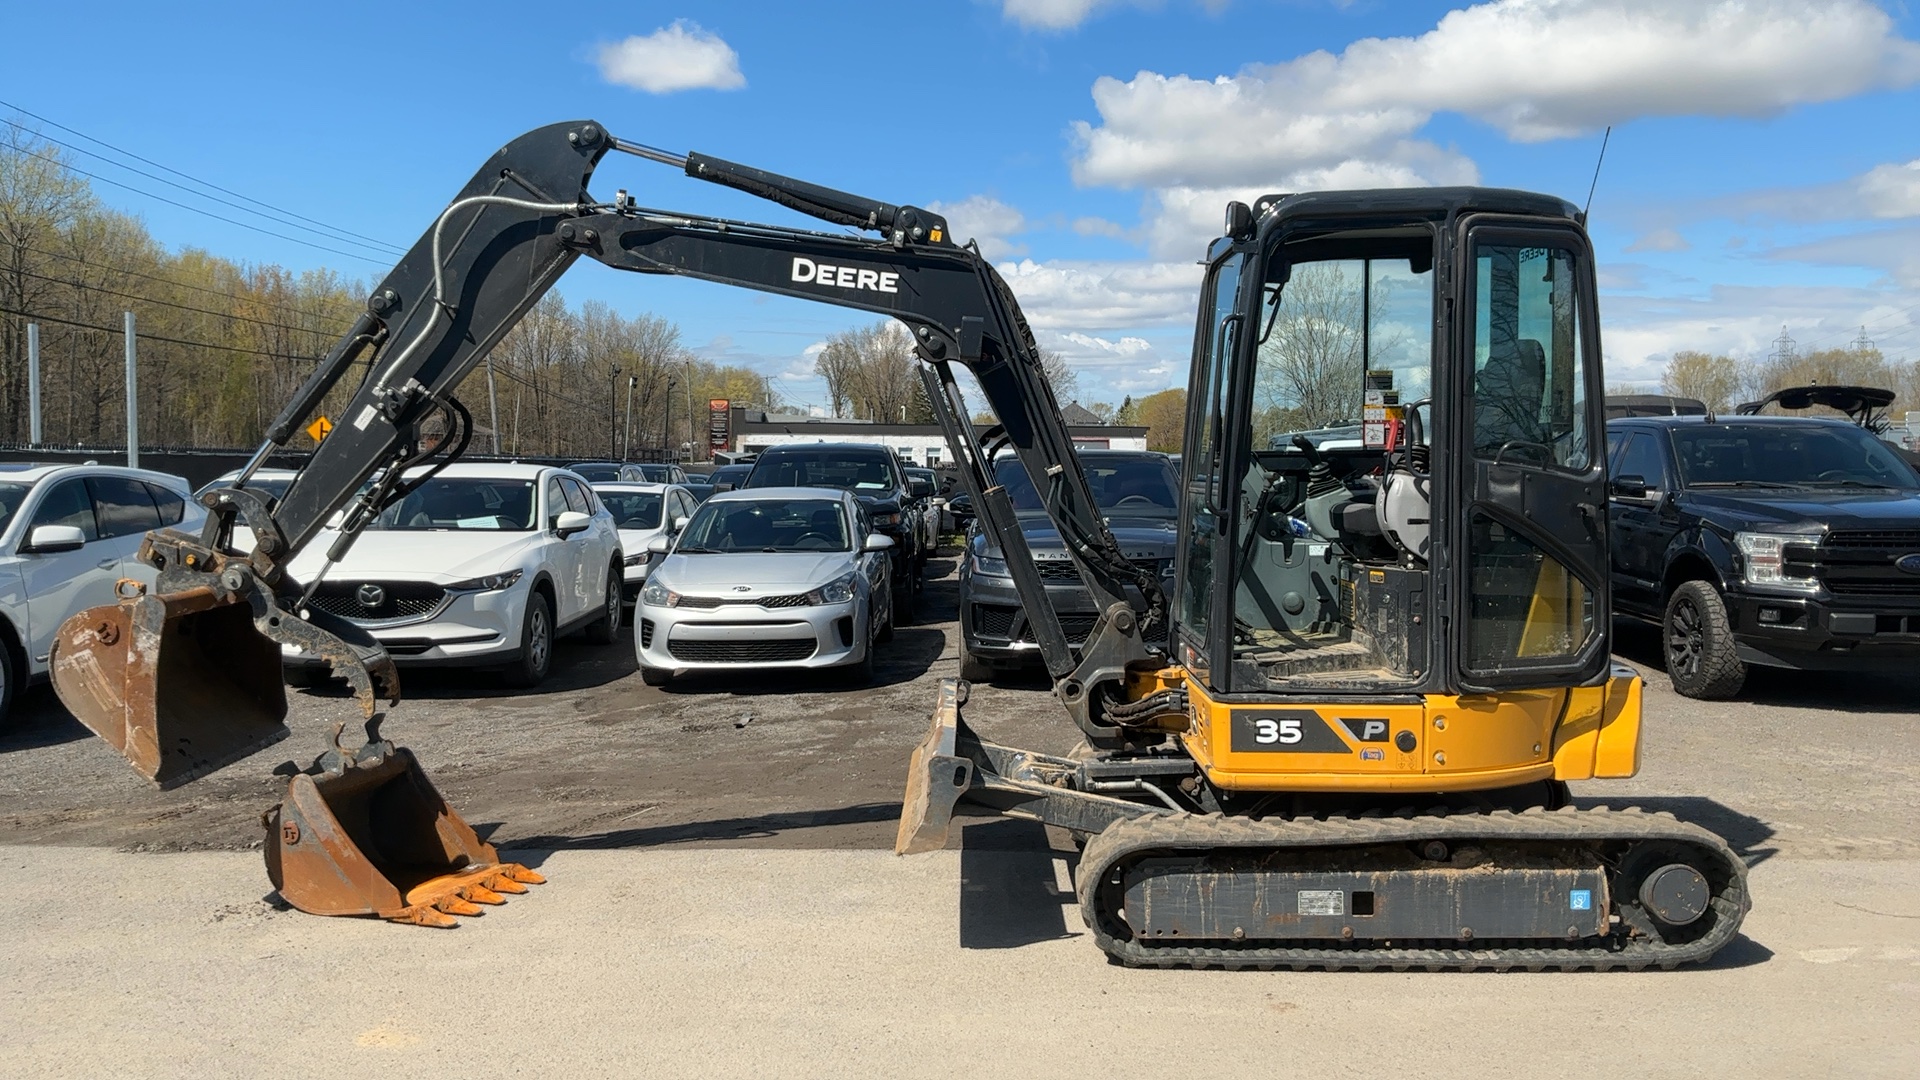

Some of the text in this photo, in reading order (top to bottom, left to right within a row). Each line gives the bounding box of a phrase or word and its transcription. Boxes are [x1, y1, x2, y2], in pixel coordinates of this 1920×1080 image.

[791, 257, 899, 293] DEERE
[1255, 719, 1385, 744] 35 P
